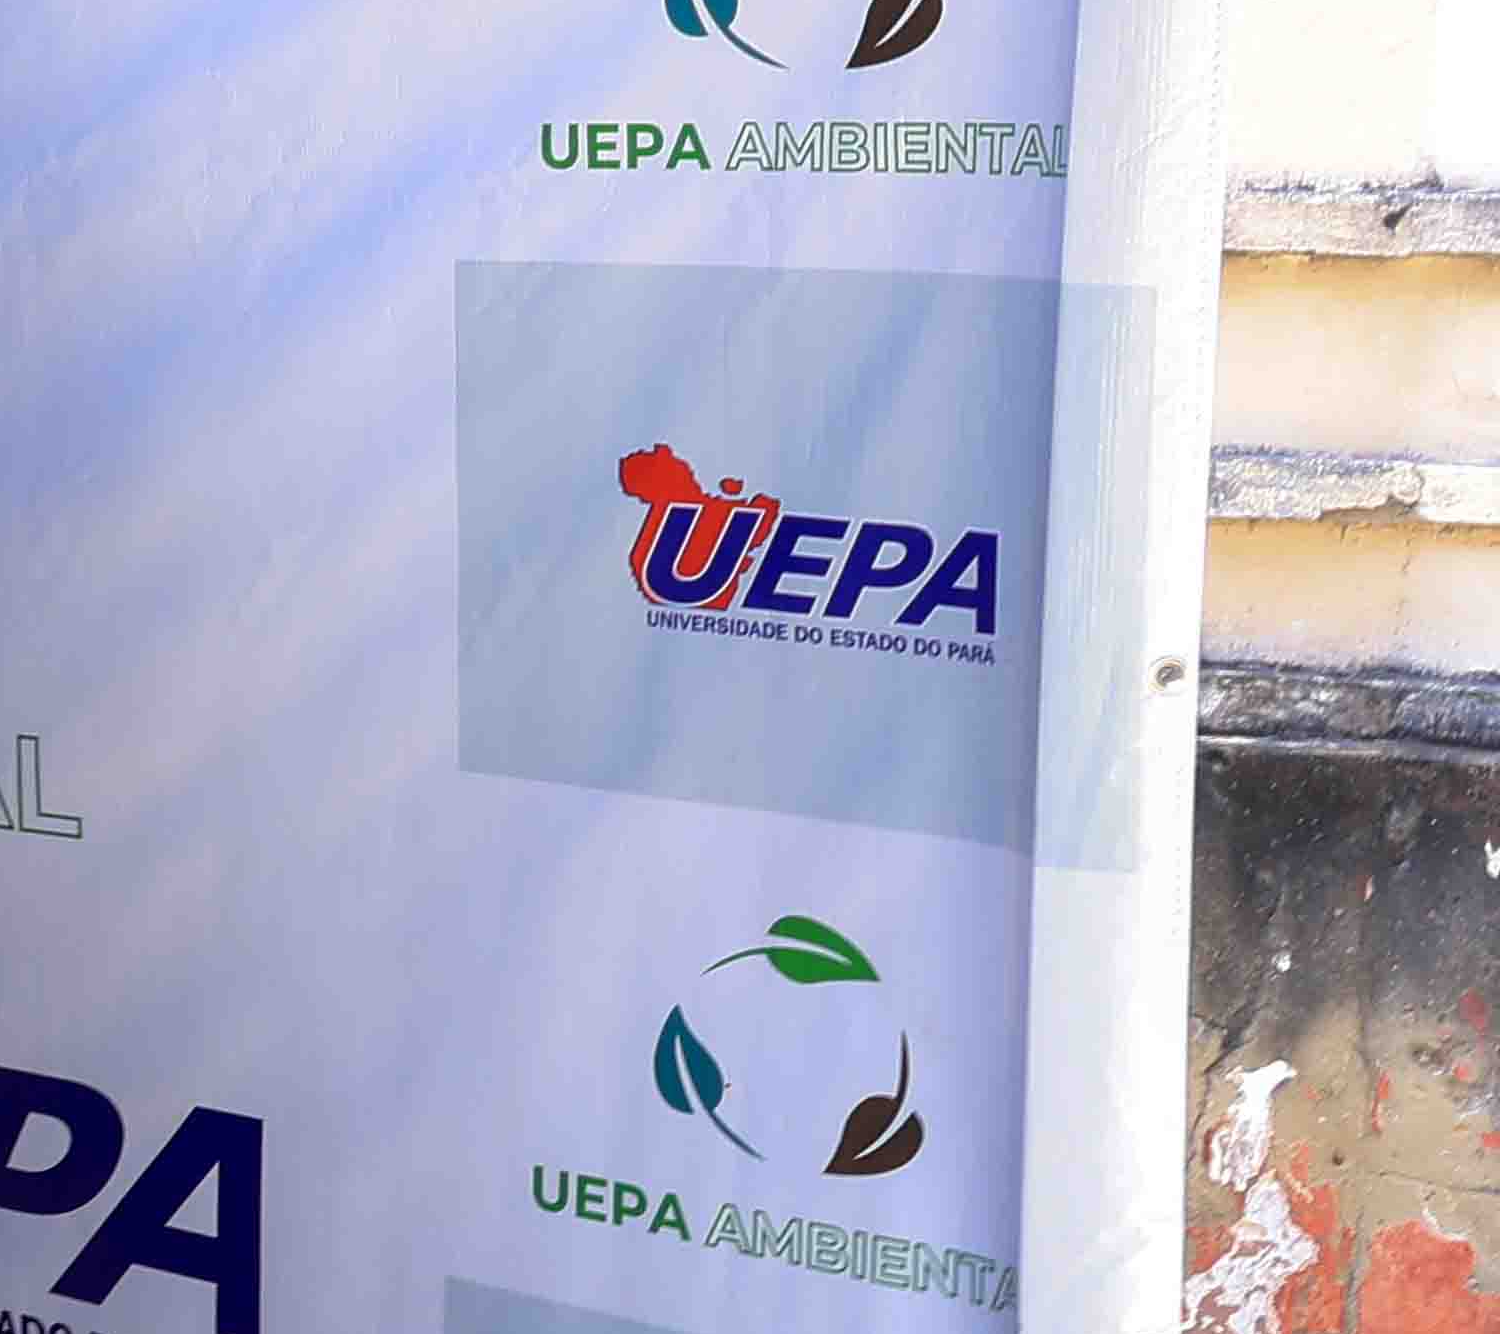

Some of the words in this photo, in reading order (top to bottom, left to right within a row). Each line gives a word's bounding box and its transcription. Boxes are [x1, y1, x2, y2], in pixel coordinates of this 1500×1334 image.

[538, 121, 712, 173] UEPA
[724, 121, 1071, 180] AMBIENTAL
[644, 504, 1000, 637] UEPA
[646, 609, 790, 643] UNIVERSIDADE
[794, 624, 823, 646] DO
[829, 627, 908, 656] ESTADO
[913, 636, 942, 659] DO
[947, 638, 997, 667] PARÁ
[533, 1165, 693, 1242] UEPA
